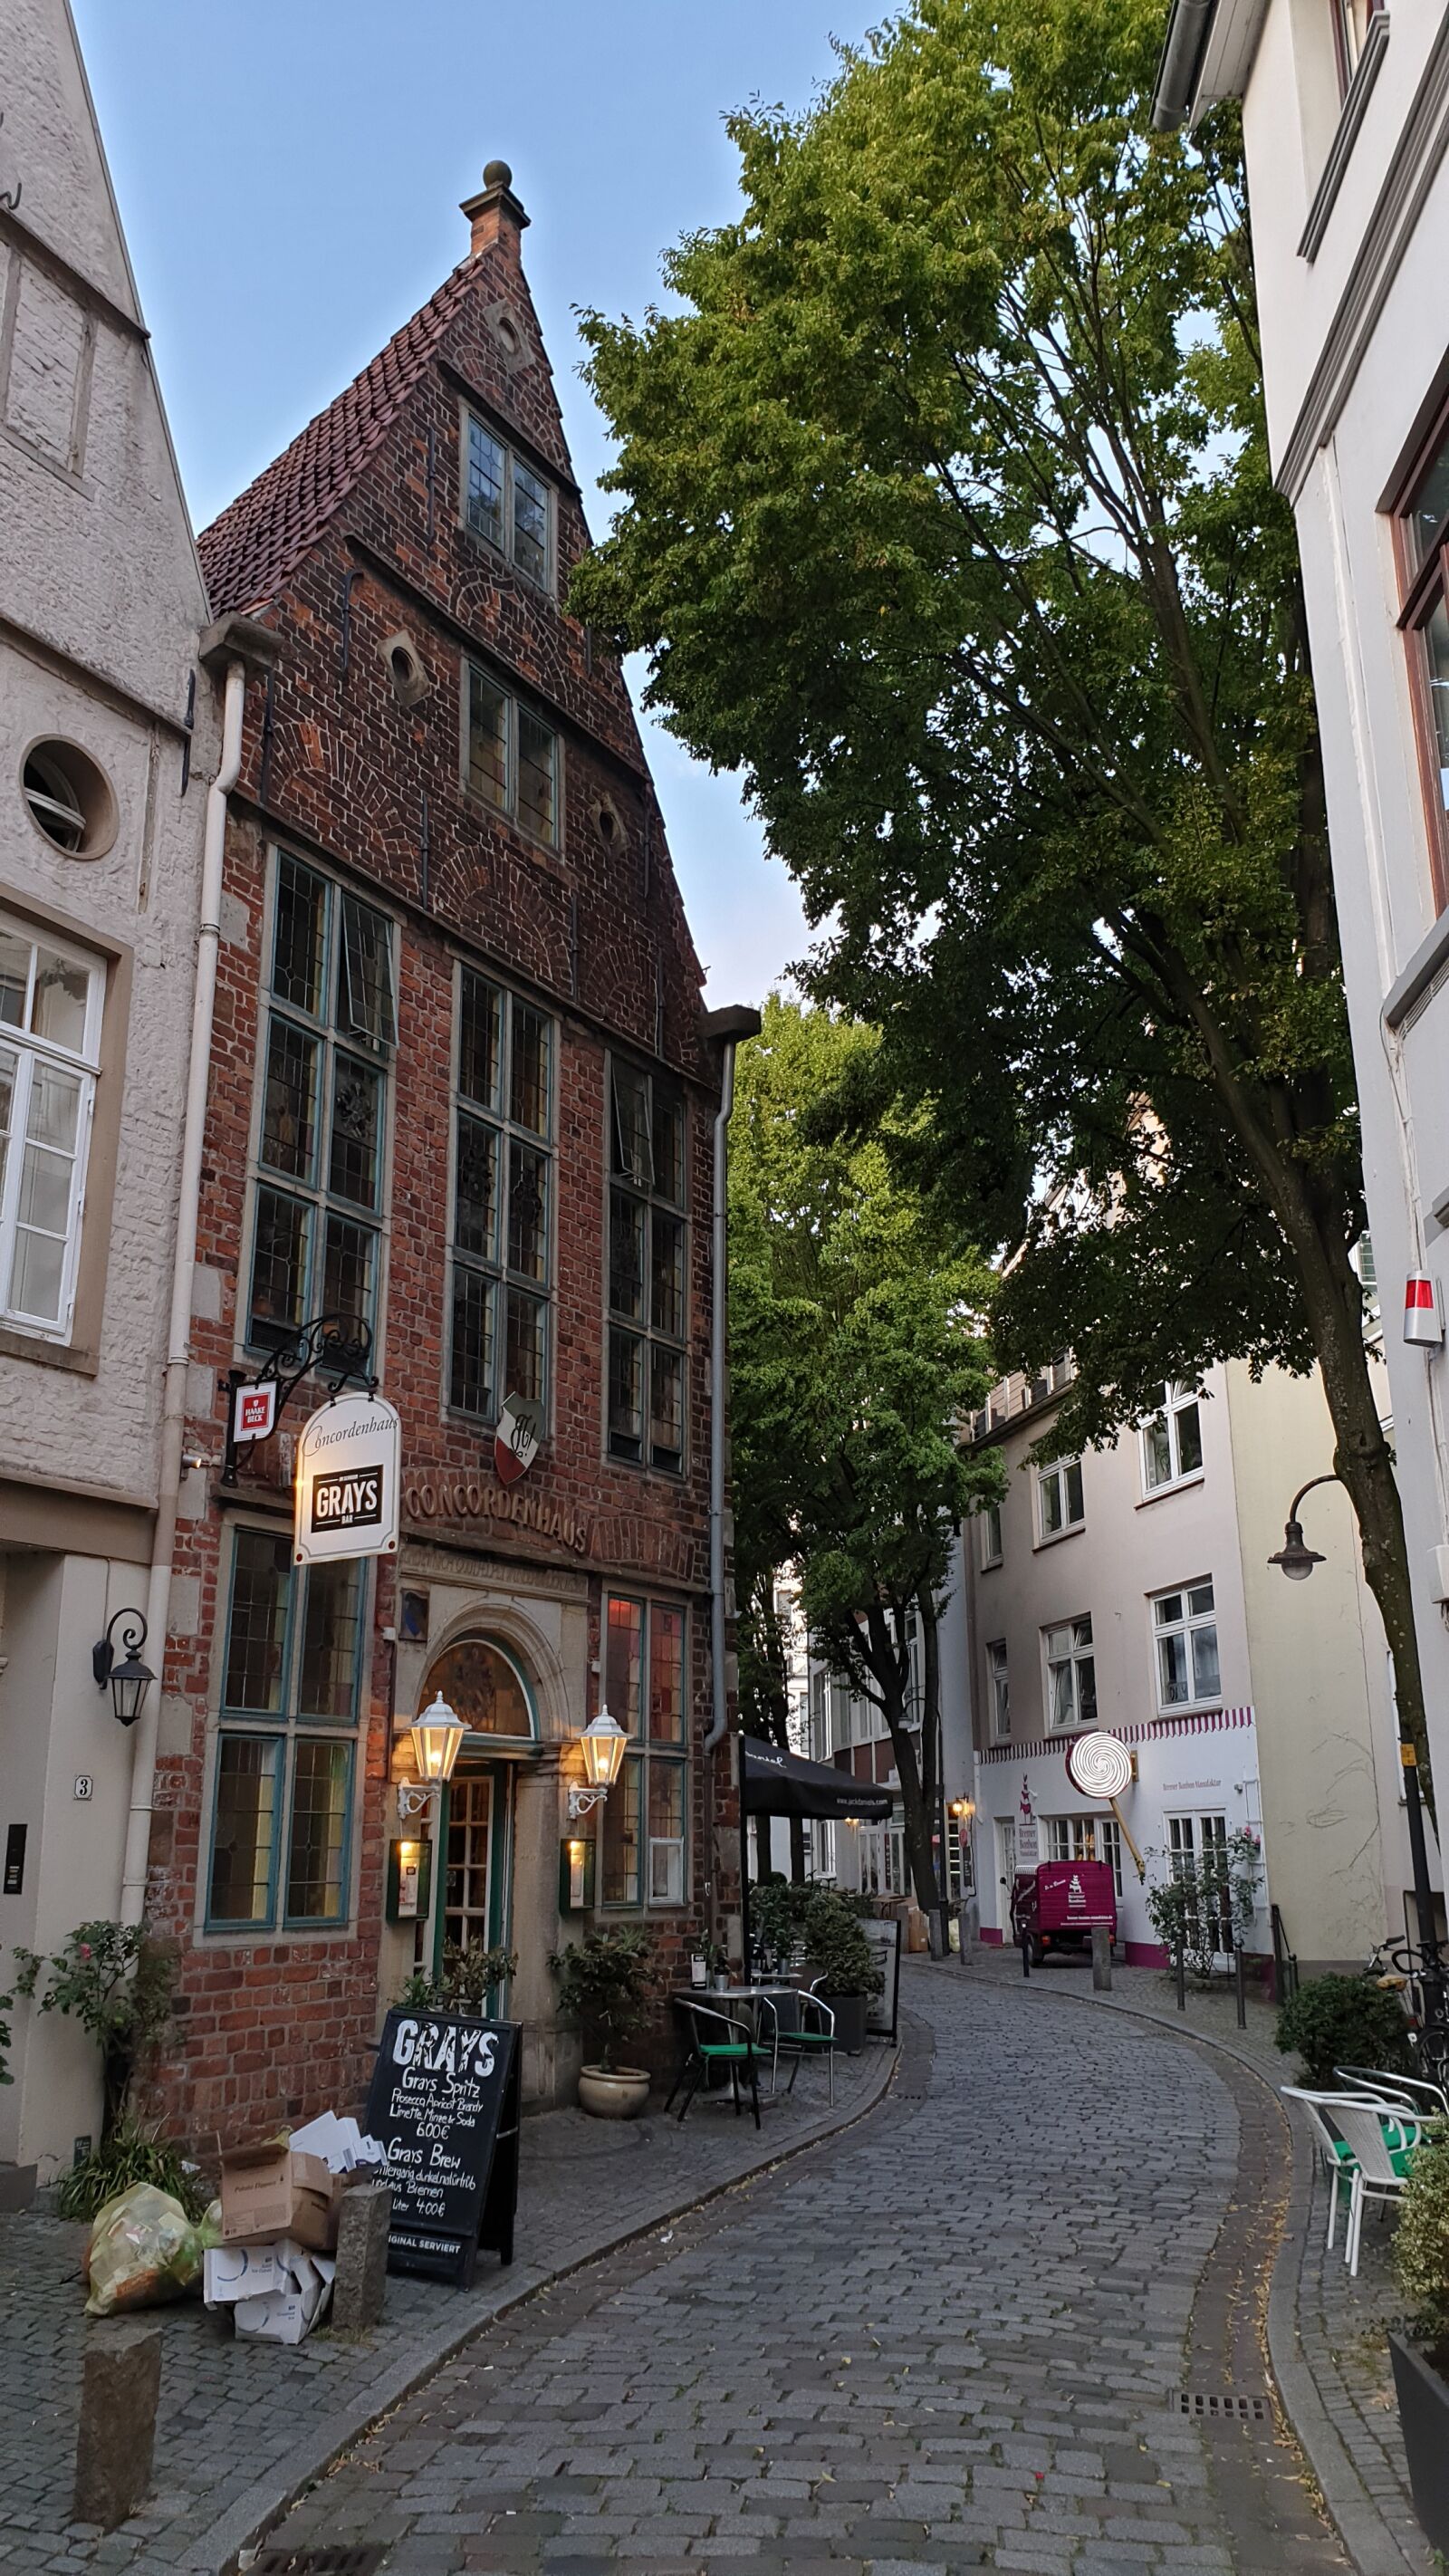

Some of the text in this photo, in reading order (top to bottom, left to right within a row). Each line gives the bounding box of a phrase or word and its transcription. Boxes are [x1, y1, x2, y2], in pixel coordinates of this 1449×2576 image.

[245, 1406, 265, 1417] HAAKE
[247, 1414, 263, 1424] BECK
[302, 1416, 399, 1457] Concordenhaus
[316, 1480, 378, 1518] GRAYS
[341, 1514, 354, 1524] BAR
[406, 1483, 587, 1554] CONCORDENHAUS
[79, 1778, 89, 1796] 3
[392, 2019, 500, 2077] GRAYS
[402, 2066, 481, 2099] Grays Spritz
[426, 2092, 456, 2110] Apricot
[456, 2097, 484, 2113] Brandy
[456, 2111, 475, 2128] Soda
[388, 2137, 461, 2169] Grays Brew
[406, 2179, 444, 2198] Bremen
[388, 2234, 461, 2254] IGINAL SERVIERT
